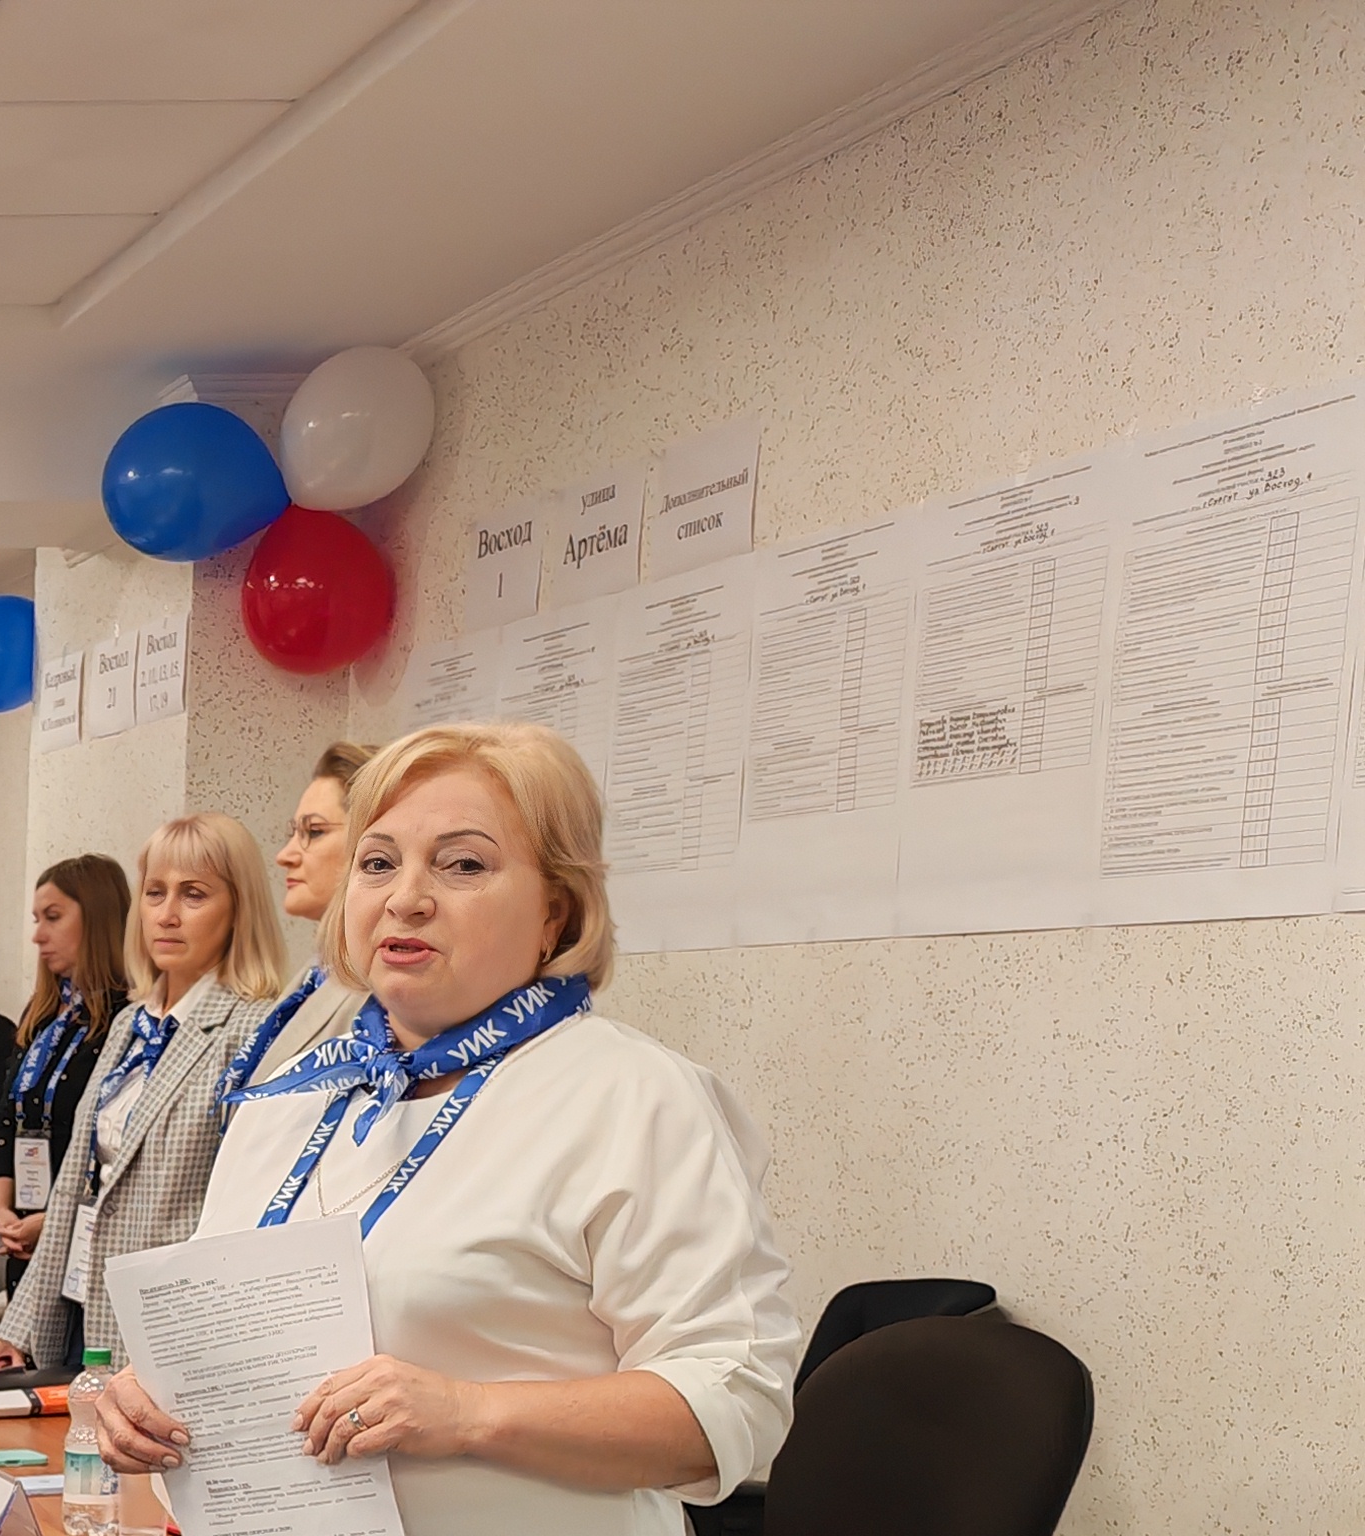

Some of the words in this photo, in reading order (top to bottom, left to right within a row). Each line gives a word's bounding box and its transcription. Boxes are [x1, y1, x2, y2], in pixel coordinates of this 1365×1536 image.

[581, 484, 616, 516] улица
[660, 468, 748, 515] Дополнительный
[478, 520, 533, 559] Восход
[563, 524, 628, 569] Артёма
[676, 511, 724, 541] список
[502, 981, 556, 1025] УИК
[235, 1031, 260, 1063] УИК
[446, 1018, 508, 1067] УИК
[426, 1095, 470, 1137] УИК
[301, 1118, 339, 1160] УИК
[268, 1171, 306, 1213] УИК
[382, 1154, 427, 1195] УИК
